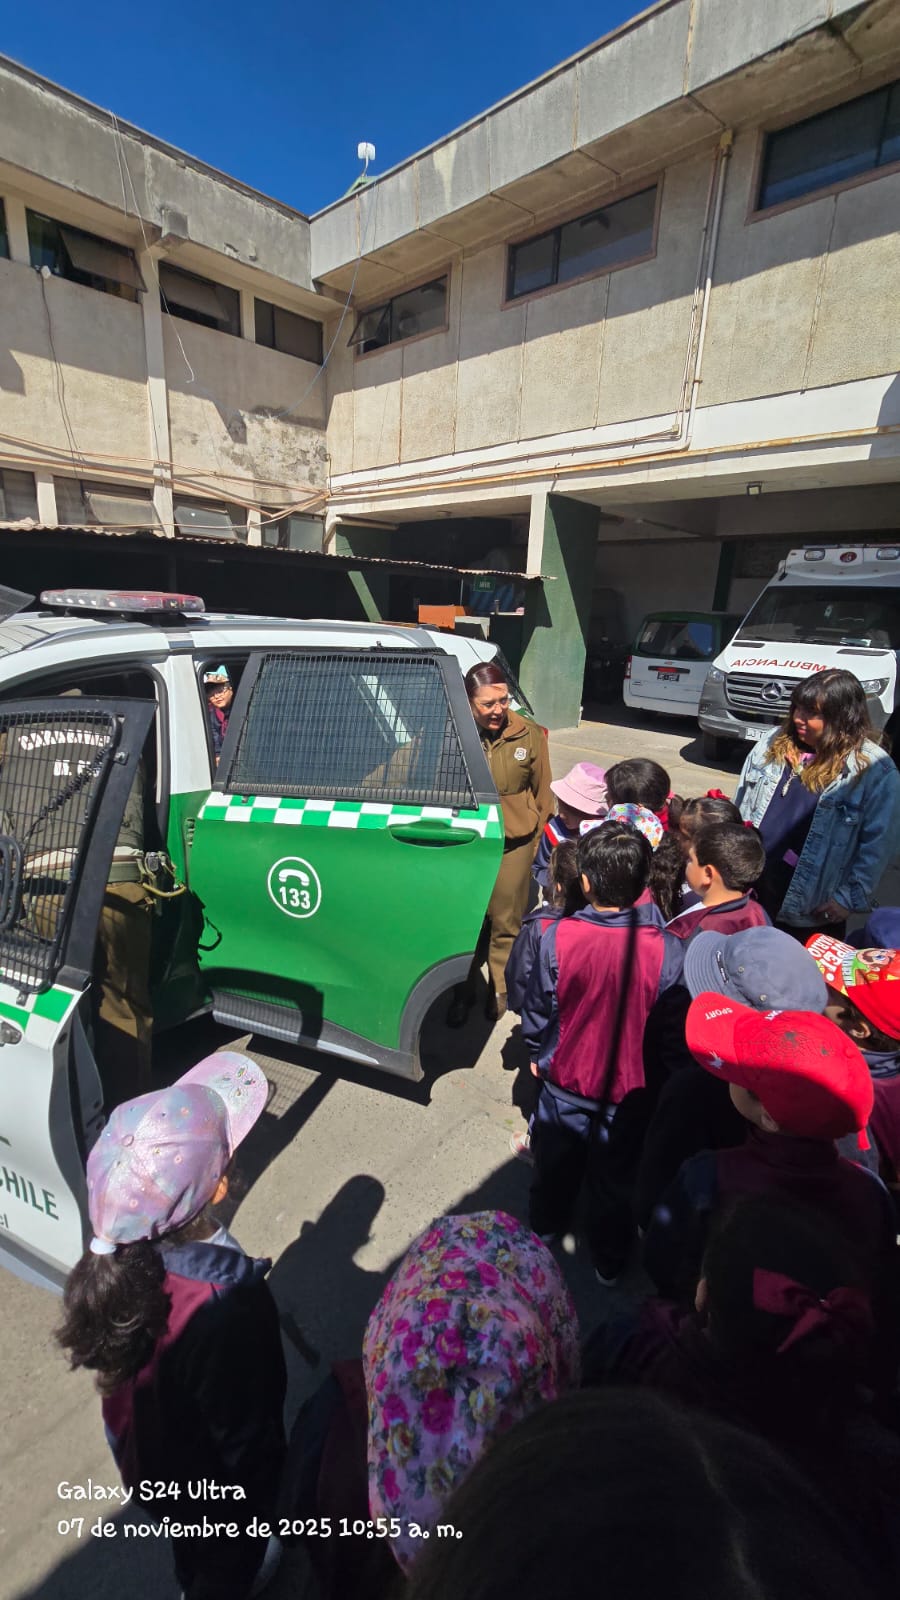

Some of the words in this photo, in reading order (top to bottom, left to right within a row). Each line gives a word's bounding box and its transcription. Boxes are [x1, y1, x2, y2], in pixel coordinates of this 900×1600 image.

[279, 886, 311, 909] 133
[705, 1007, 734, 1020] SPORT
[0, 1166, 59, 1220] HILE
